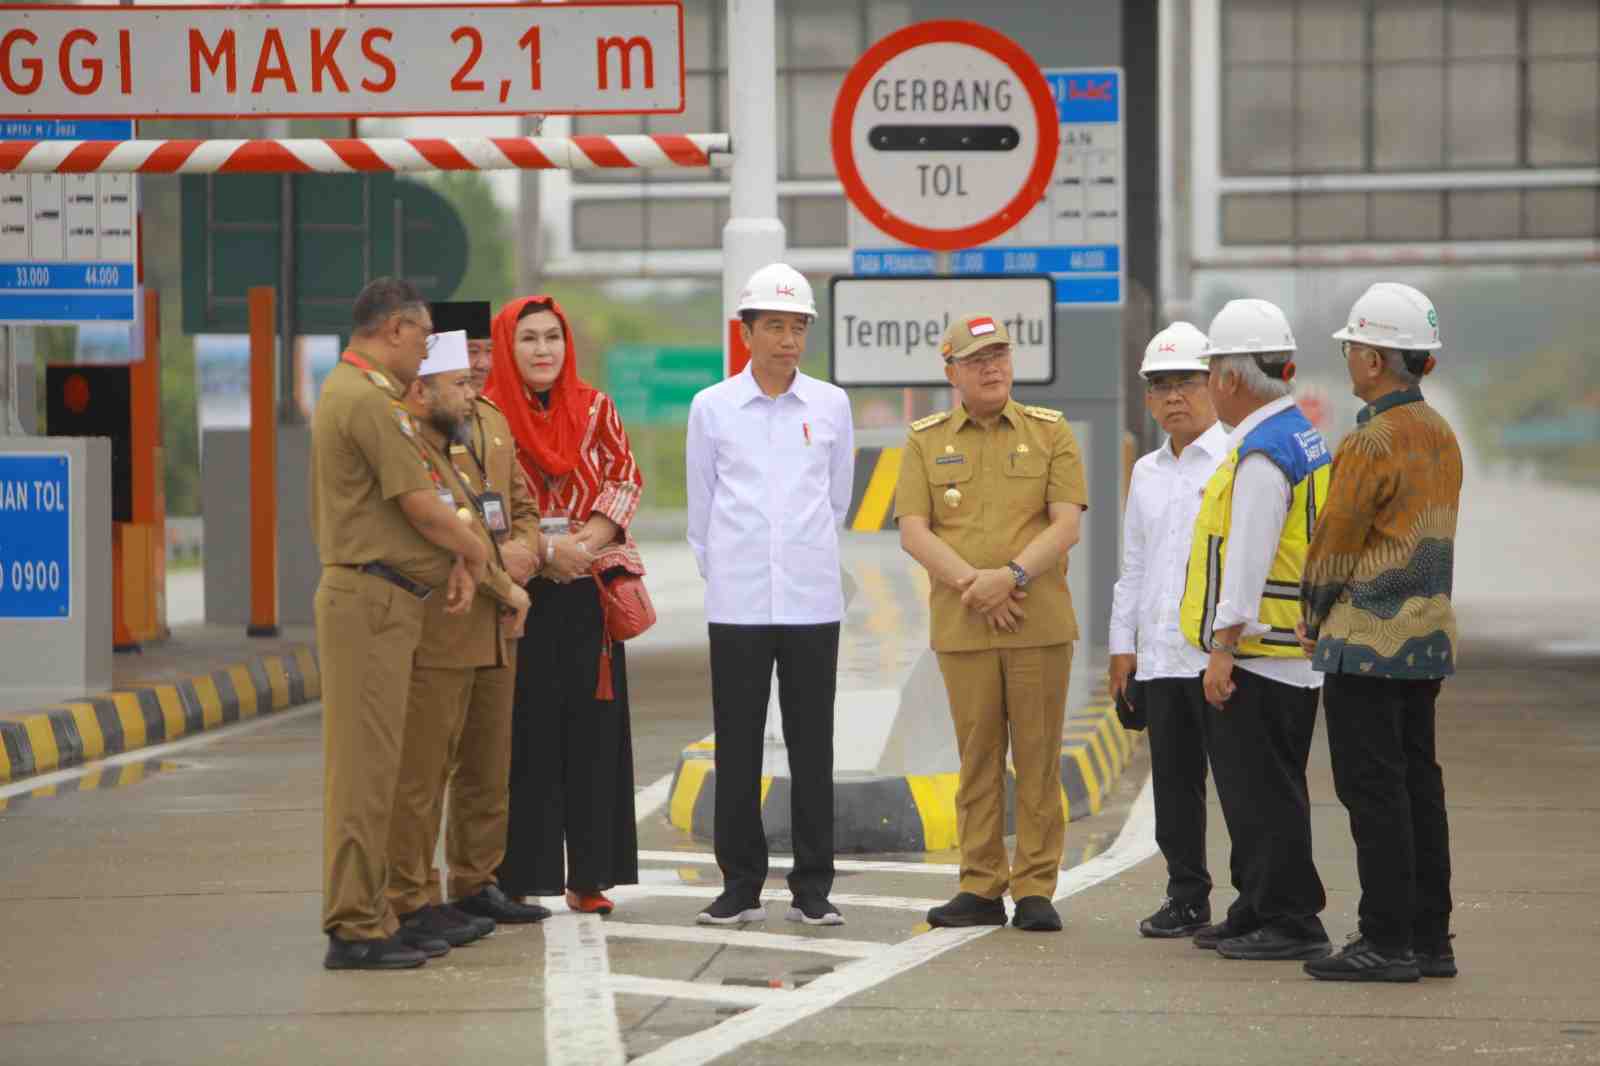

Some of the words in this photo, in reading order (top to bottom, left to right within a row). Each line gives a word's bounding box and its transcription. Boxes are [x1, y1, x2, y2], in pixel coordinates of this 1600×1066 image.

[189, 27, 397, 94] MAKS
[450, 25, 542, 103] 2,1
[596, 36, 654, 90] m
[873, 78, 1012, 112] GERBANG
[916, 164, 969, 197] TOL
[16, 266, 49, 287] 33.000
[85, 266, 119, 287] 44.000
[34, 480, 64, 511] TOL
[12, 560, 60, 592] 0900
